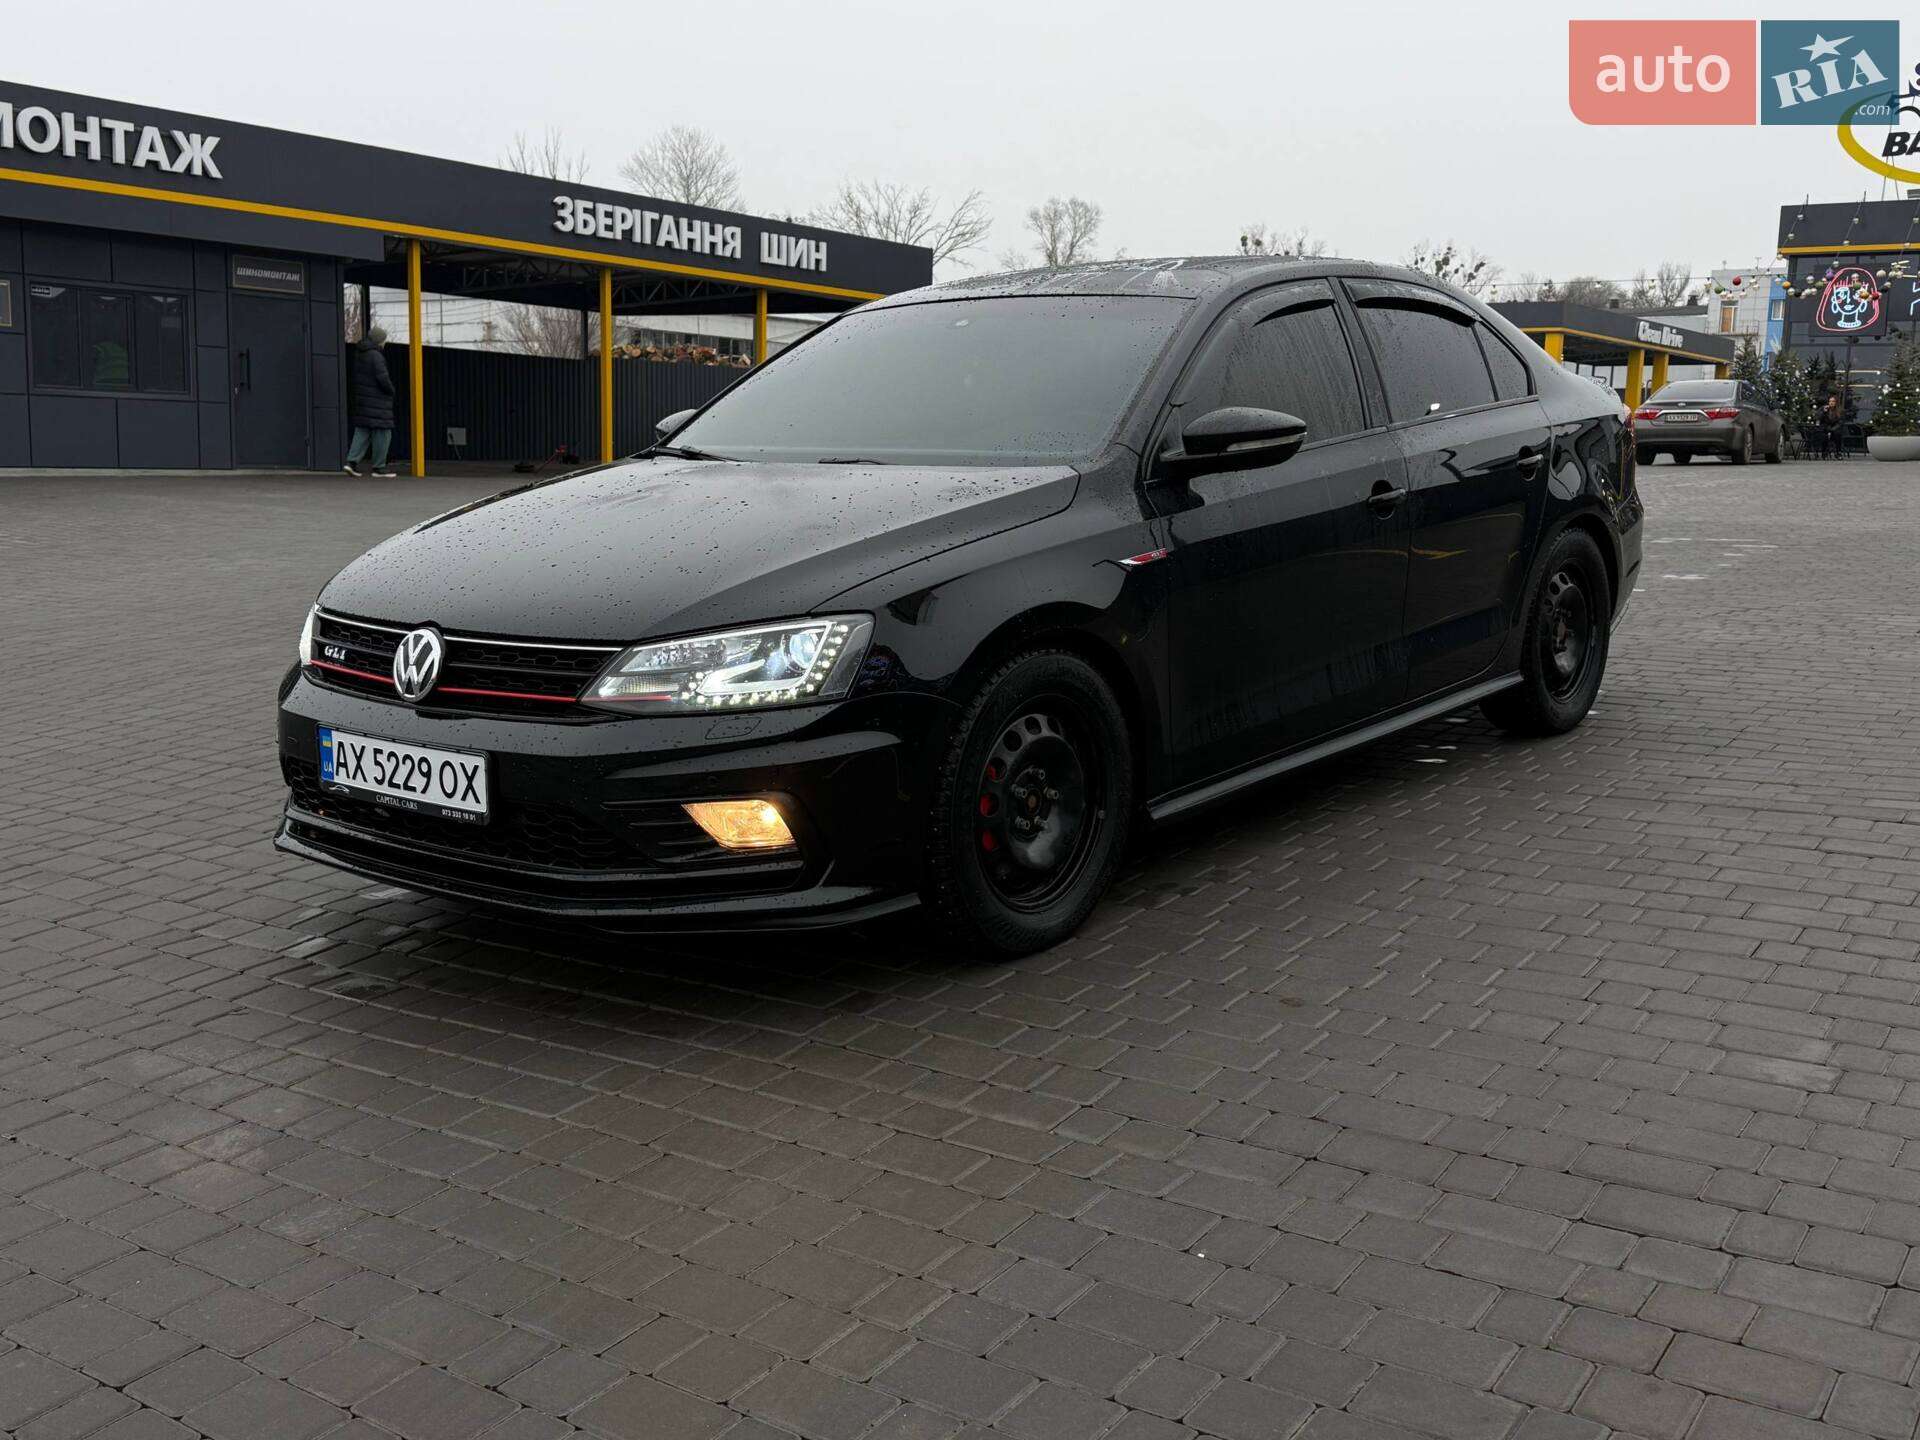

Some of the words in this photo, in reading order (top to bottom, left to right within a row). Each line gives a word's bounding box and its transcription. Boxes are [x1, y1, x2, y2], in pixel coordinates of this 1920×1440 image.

[552, 195, 742, 259] ЗБЕРІГАННЯ
[760, 231, 828, 272] ШИН
[236, 267, 300, 281] ШИНОМОНТАЖ
[324, 645, 346, 660] GLI
[323, 761, 333, 773] UA
[335, 740, 368, 783] AX
[373, 748, 432, 794] 5229
[438, 760, 481, 804] OX
[376, 795, 401, 806] CAPITAL
[401, 800, 418, 810] CARS
